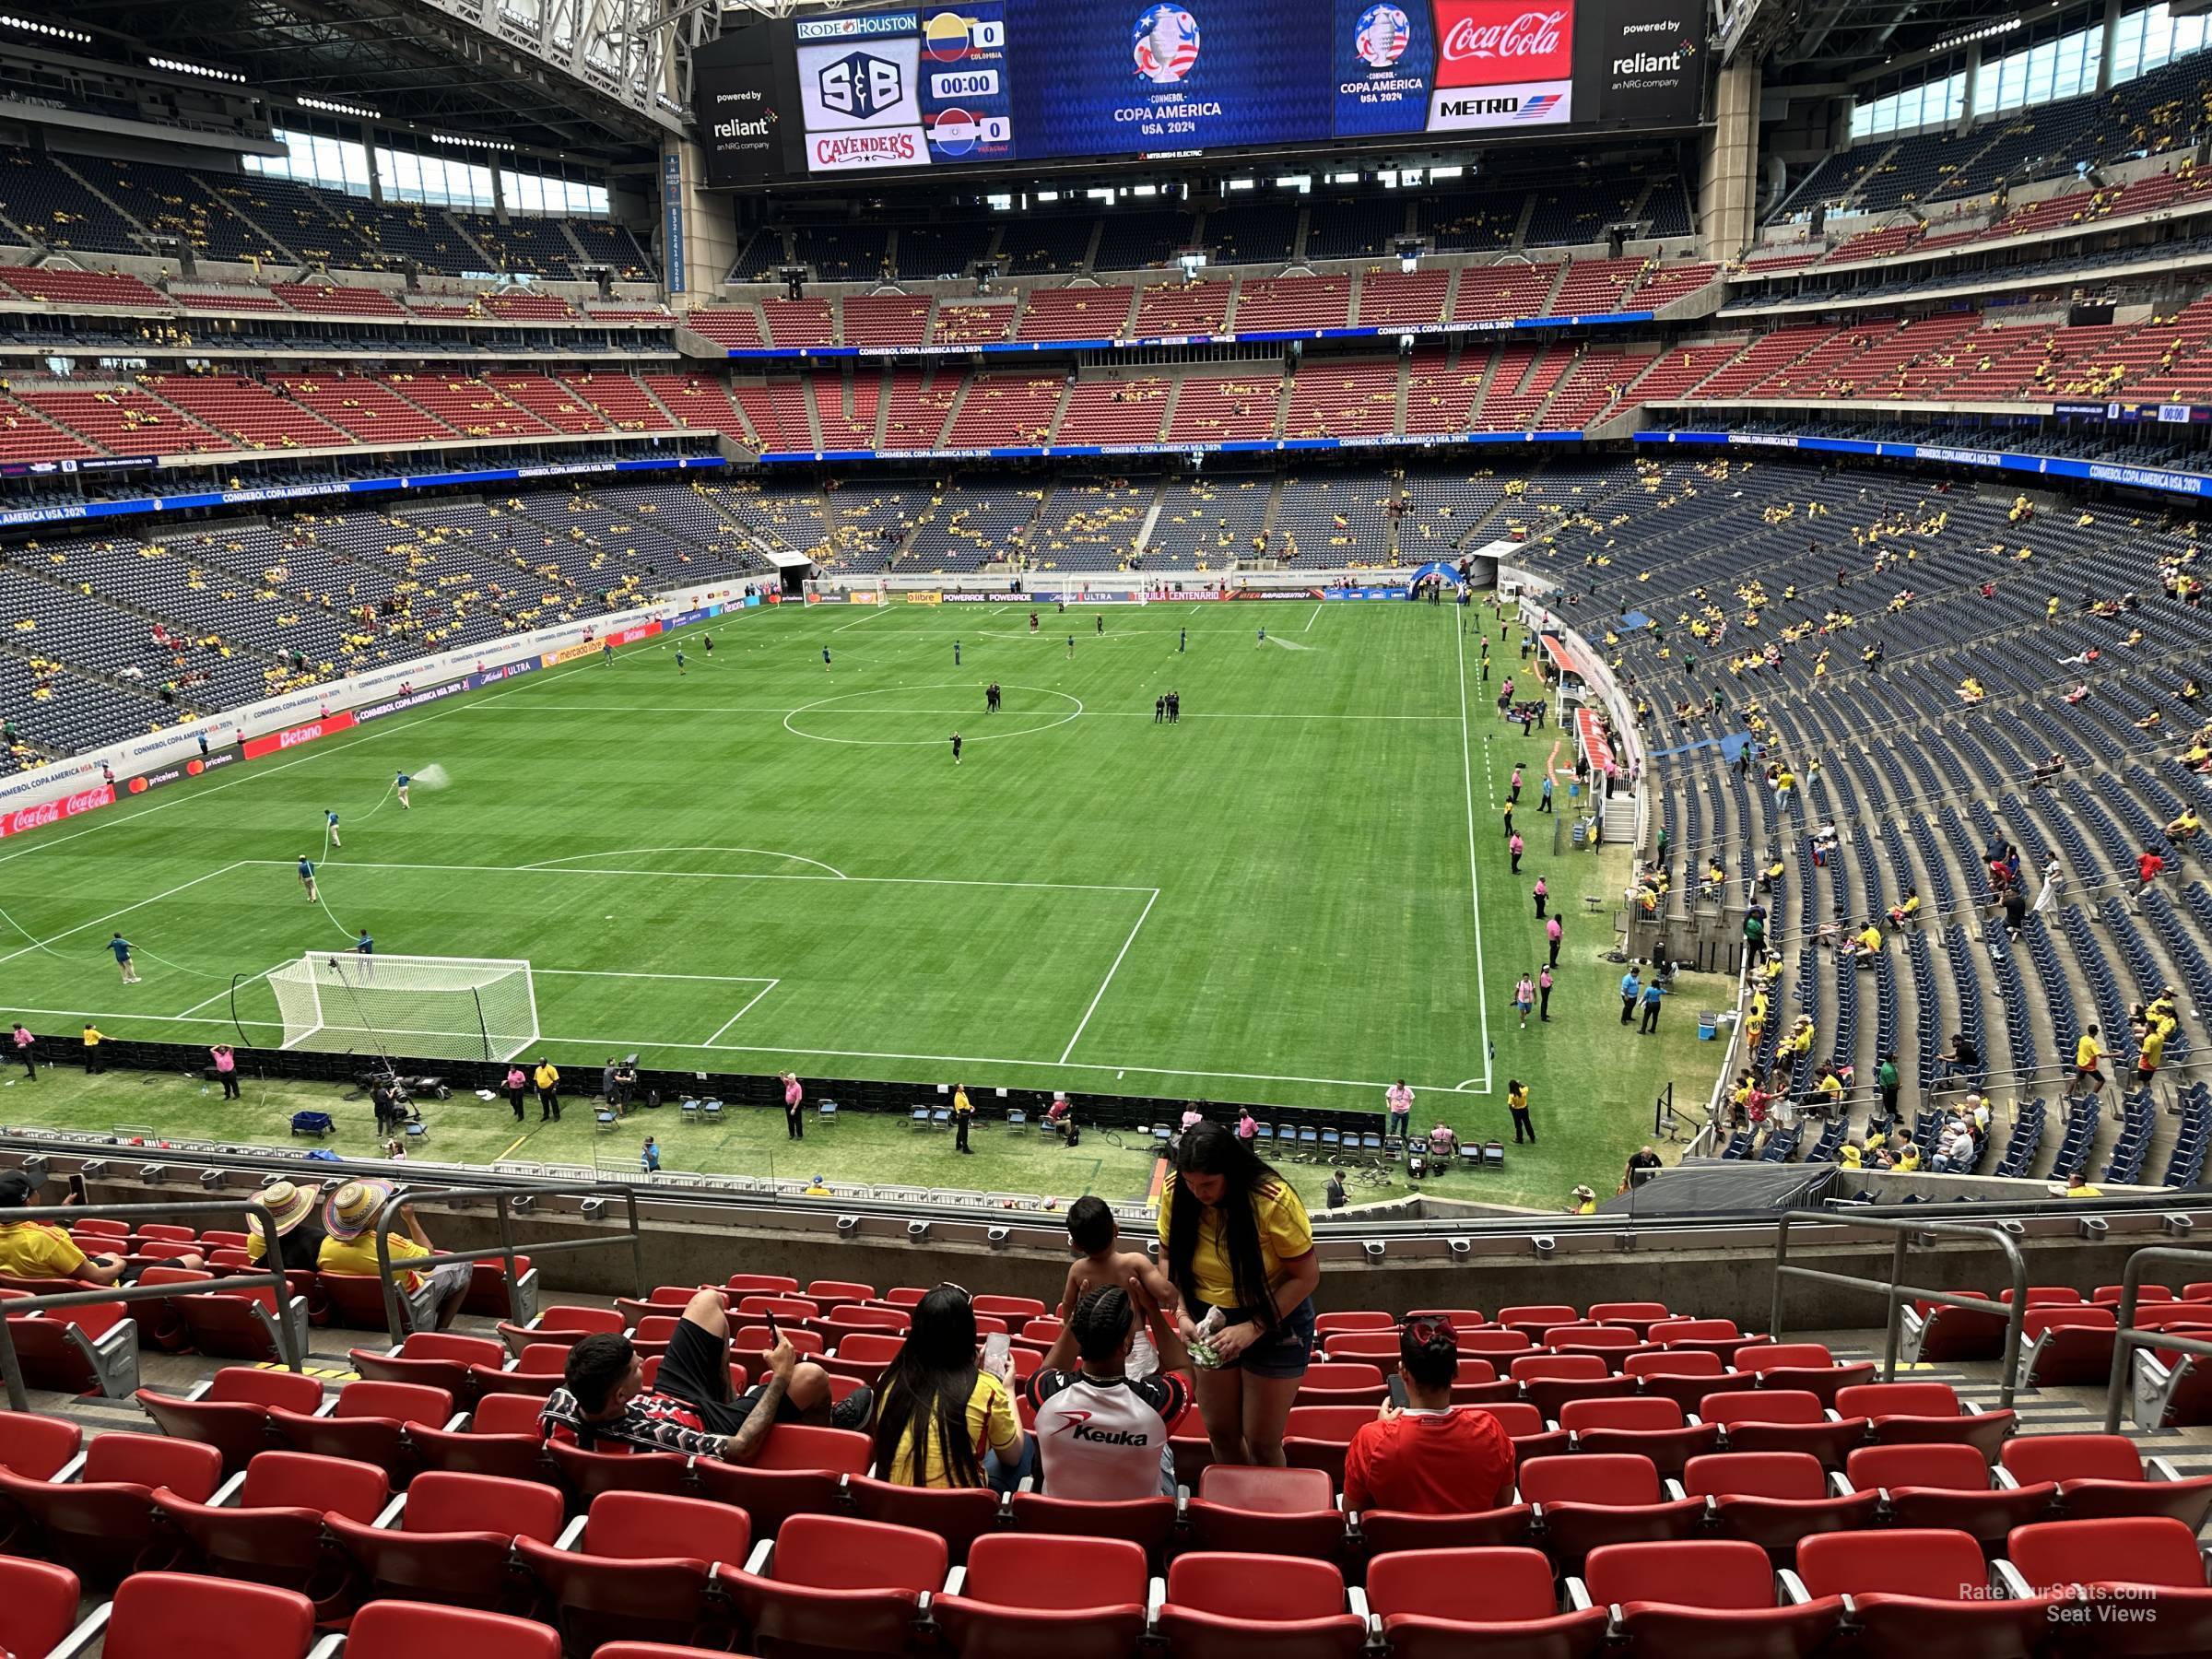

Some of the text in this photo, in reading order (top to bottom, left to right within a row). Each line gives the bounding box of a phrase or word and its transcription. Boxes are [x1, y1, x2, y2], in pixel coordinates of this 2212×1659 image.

[983, 27, 994, 42] 0
[1623, 20, 1680, 35] powered by
[1442, 10, 1568, 62] Coca-Cola
[971, 52, 1003, 61] COLOMBIA
[1613, 52, 1680, 75] reliant
[941, 76, 990, 95] 00:00
[1340, 78, 1423, 93] COPA AMERICA
[1623, 79, 1641, 88] NRG
[1642, 78, 1678, 88] company
[717, 91, 761, 103] powered by
[1360, 92, 1402, 103] USA 2024
[1114, 102, 1221, 122] COPA AMERICA
[1441, 97, 1518, 117] METRO
[714, 118, 768, 137] reliant
[990, 123, 1000, 138] 0
[1141, 121, 1195, 135] USA 2024
[725, 143, 740, 151] NRG
[741, 142, 769, 151] company
[817, 133, 915, 164] CAVENDER'S
[1147, 149, 1202, 159] MITSUBISHI ELECTRIC
[1378, 321, 1514, 335] CONMEBOL COPA AMERICA USA 2024
[859, 345, 982, 356] CONMEBOL COPA AMERICA USA 2024
[1159, 444, 1190, 453] AMERICA
[1191, 443, 1205, 452] USA
[1339, 439, 1381, 447] CONMEBOL
[1402, 436, 1435, 444] AMERICA
[1436, 435, 1450, 443] USA
[1451, 435, 1469, 443] 2024
[932, 450, 960, 458] AMERICA
[974, 449, 991, 457] 2024
[66, 461, 73, 470] 0
[2123, 470, 2140, 484] COPA
[2138, 472, 2169, 488] AMERICA
[2169, 476, 2183, 490] USA
[2183, 477, 2203, 493] 2024
[223, 484, 350, 502] CONMEBOL COPA AMERICA USA 2024
[2, 512, 45, 524] AMERICA
[46, 509, 64, 521] USA
[65, 506, 87, 518] 2024
[915, 594, 935, 602] libre
[943, 594, 984, 602] POWERADE
[989, 594, 1031, 602] POWERADE
[1084, 593, 1112, 601] ULTRA
[1169, 592, 1219, 600] CENTENARIO
[724, 600, 745, 613] Rexona
[559, 641, 602, 661] mercado libre
[508, 661, 531, 676] ULTRA
[253, 706, 282, 719] CONMEBOL
[282, 701, 297, 712] COPA
[296, 695, 319, 709] AMERICA
[359, 702, 395, 721] CONMEBOL
[394, 698, 412, 710] COPA
[411, 691, 437, 706] AMERICA
[134, 740, 167, 756] CONMEBOL
[168, 735, 183, 746] COPA
[208, 724, 219, 734] USA
[280, 724, 322, 748] Betano
[205, 753, 232, 770] priceless
[30, 776, 51, 789] COPA
[51, 767, 79, 783] AMERICA
[79, 762, 93, 773] USA
[149, 771, 180, 786] priceless
[1073, 1424, 1147, 1446] Keuka
